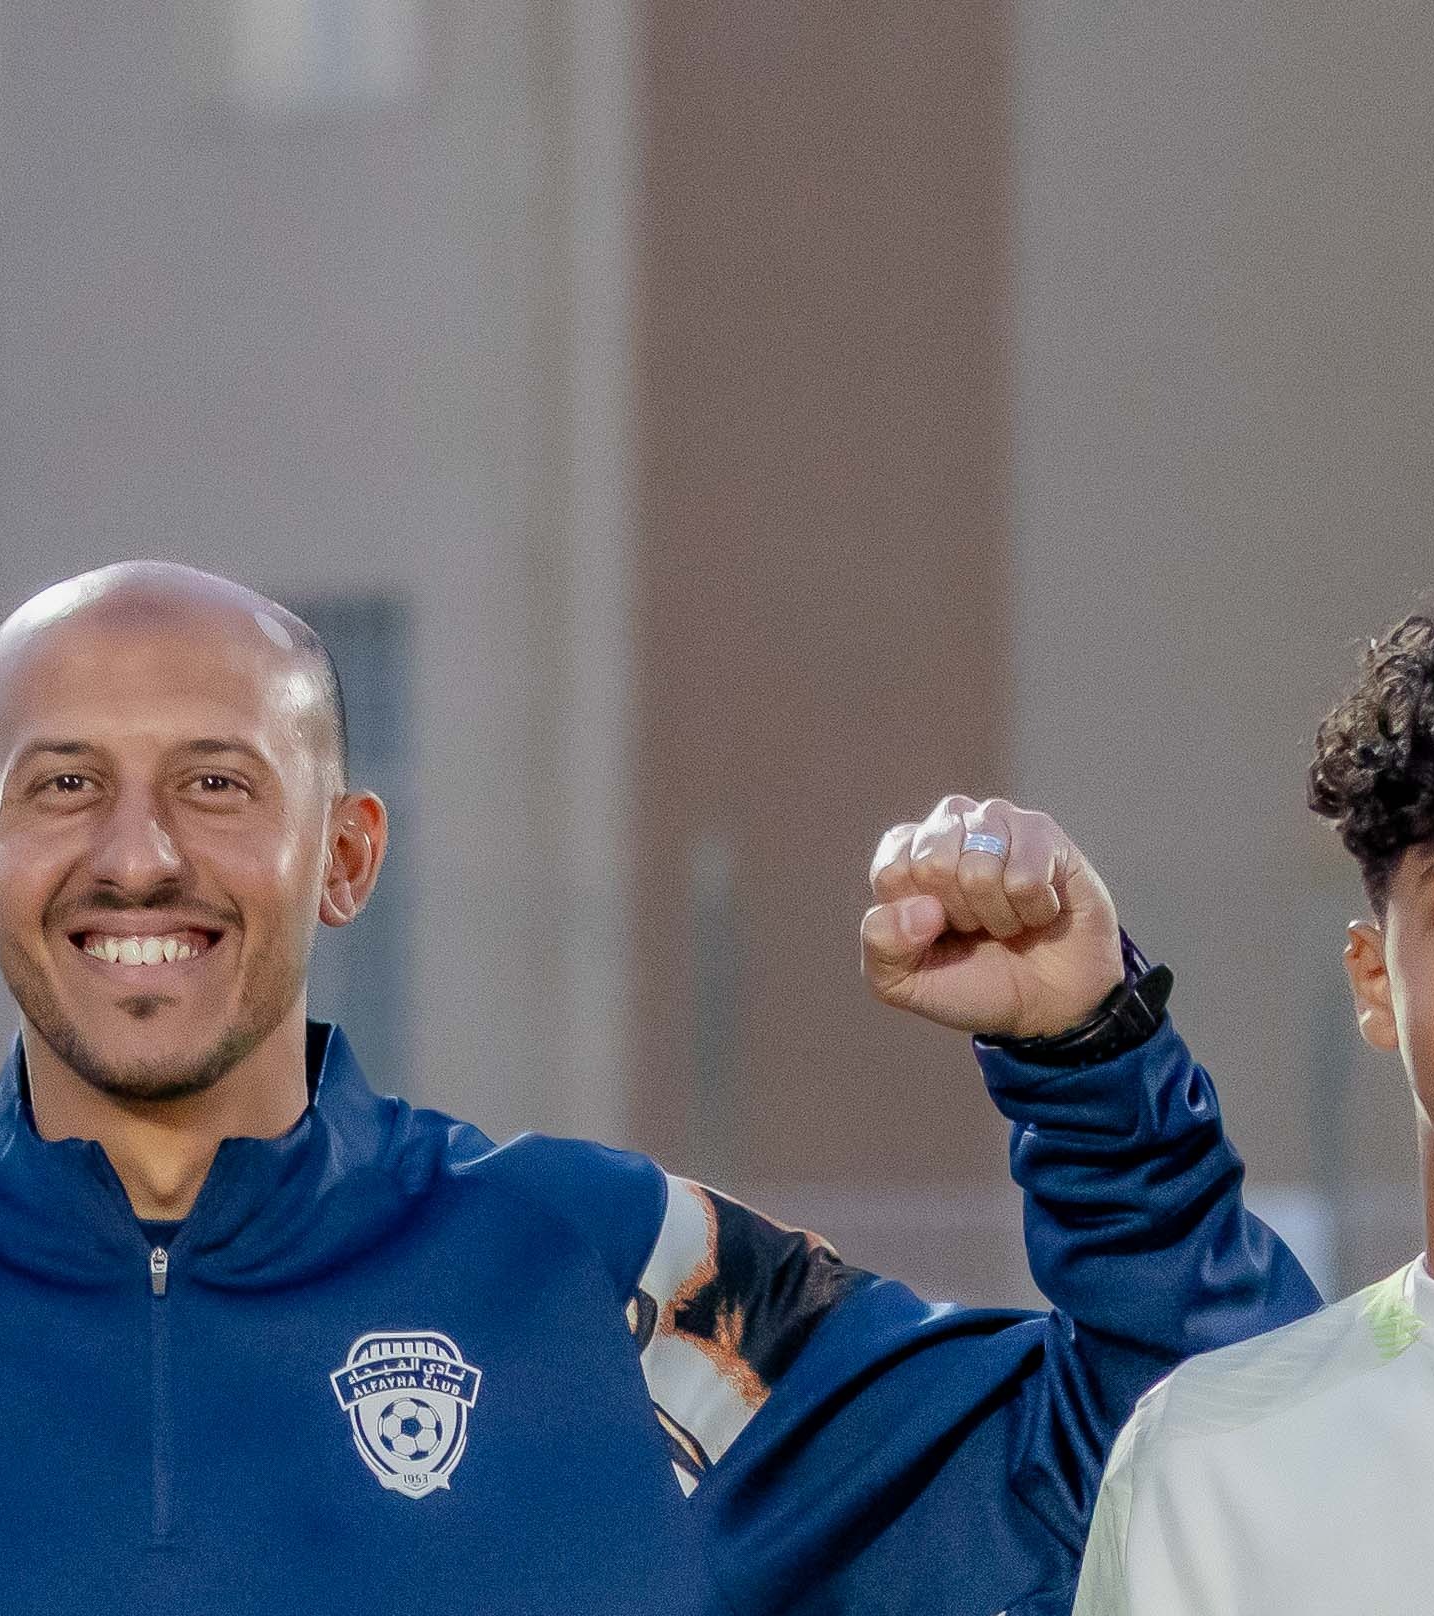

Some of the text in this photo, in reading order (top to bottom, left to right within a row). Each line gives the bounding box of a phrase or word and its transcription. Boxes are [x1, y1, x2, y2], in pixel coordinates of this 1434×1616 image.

[348, 1358, 466, 1385] نادي الفيحاء
[354, 1375, 461, 1398] ALFAYHA CLUB
